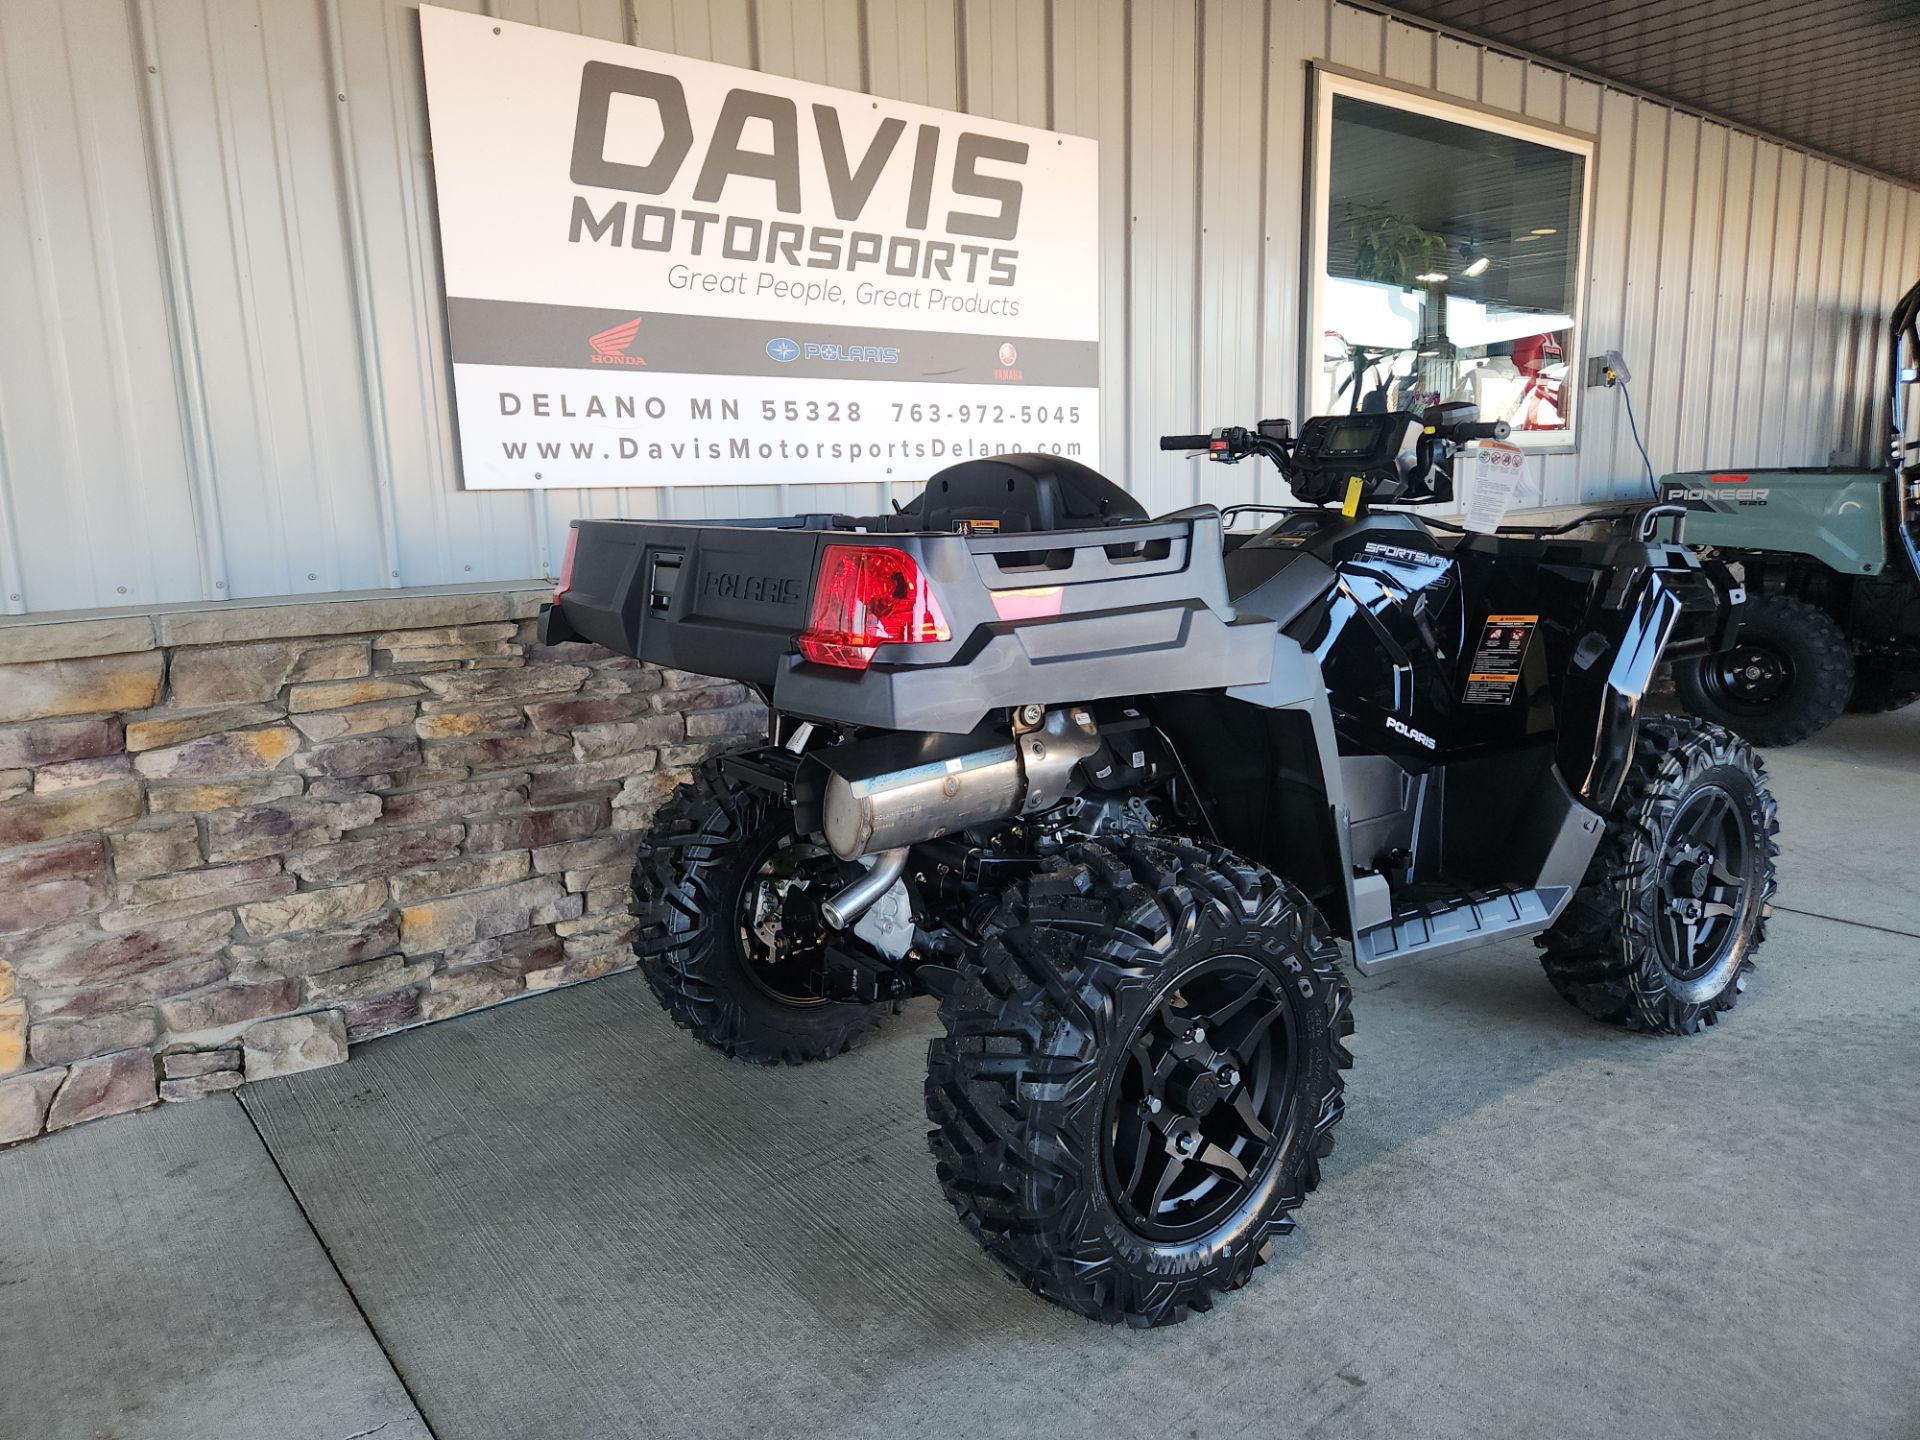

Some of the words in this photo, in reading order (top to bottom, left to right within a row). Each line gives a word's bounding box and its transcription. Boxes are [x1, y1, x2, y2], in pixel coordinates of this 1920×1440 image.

[570, 60, 1030, 241] DAVIS
[568, 195, 1020, 287] MOTORSPORTS
[668, 264, 748, 294] Great
[756, 272, 847, 306] People,
[856, 282, 921, 309] Great
[928, 288, 1020, 317] Products
[591, 354, 647, 366] HONDA
[804, 343, 898, 364] POLARIS
[994, 369, 1022, 381] YAMAHA
[499, 392, 666, 419] DELANO
[690, 398, 739, 420] MN
[762, 399, 862, 422] 55328
[891, 402, 1081, 424] 763-972-5045
[1668, 488, 1770, 500] PIONEER
[1364, 542, 1454, 569] SPORTSMAN
[704, 572, 802, 605] POLARIS
[1386, 716, 1436, 750] POLARIS
